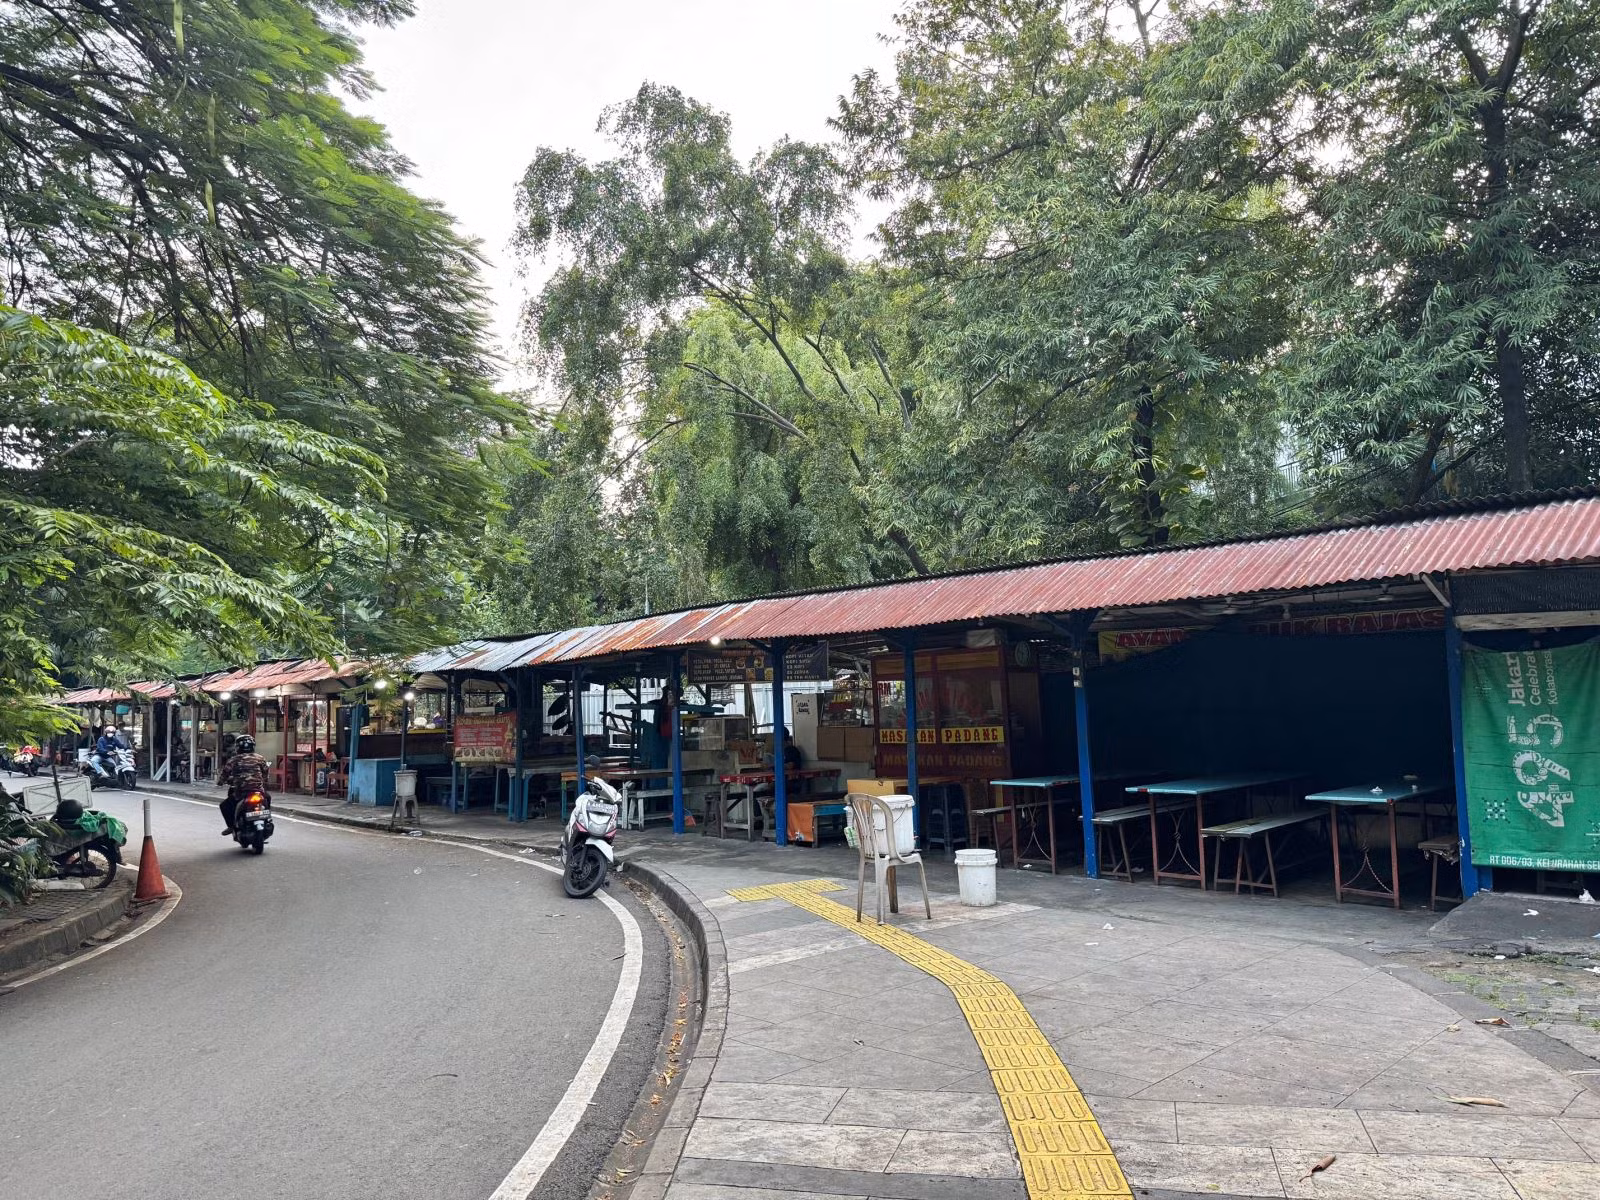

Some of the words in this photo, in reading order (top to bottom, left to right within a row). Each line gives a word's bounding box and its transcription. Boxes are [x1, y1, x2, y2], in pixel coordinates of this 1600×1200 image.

[944, 728, 999, 743] PADANG
[948, 754, 1003, 768] PADANG
[1489, 855, 1500, 865] RT
[1536, 858, 1585, 870] KELURAHAN
